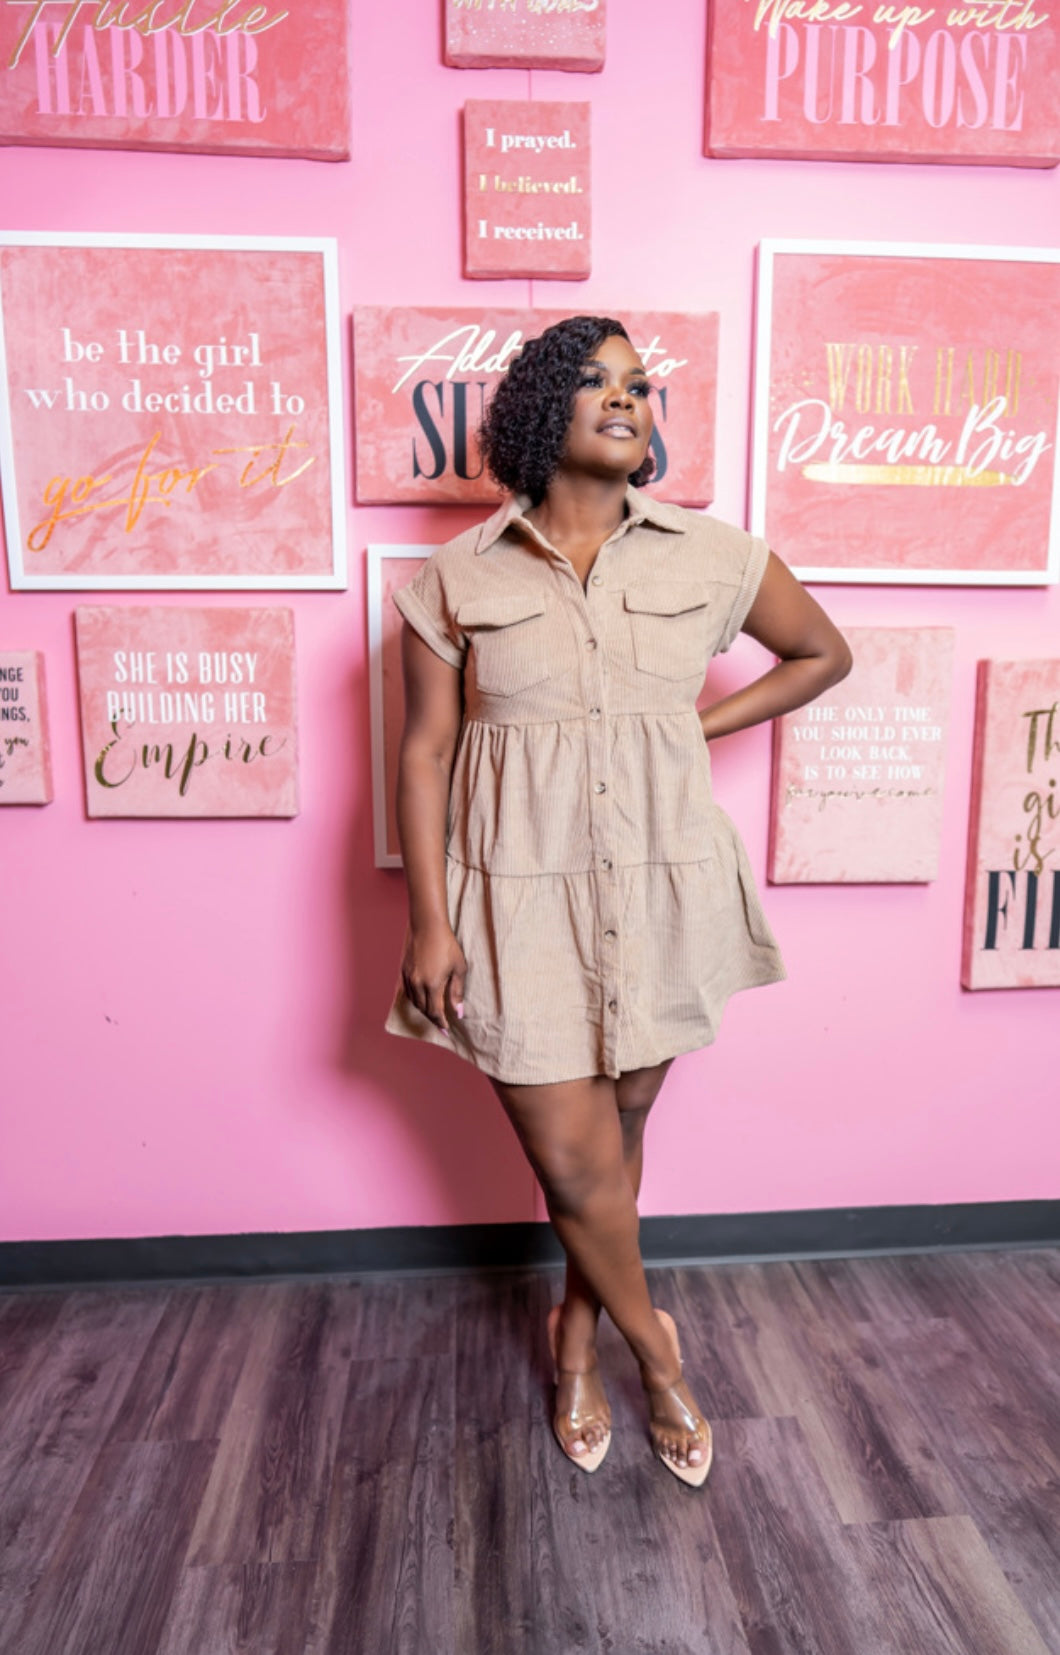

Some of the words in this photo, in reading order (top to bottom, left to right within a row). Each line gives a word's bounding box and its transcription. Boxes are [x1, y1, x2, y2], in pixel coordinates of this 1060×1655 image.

[873, 1, 934, 50] up
[946, 0, 1048, 30] with
[34, 22, 267, 124] HARDER
[760, 22, 1028, 132] PURPOSE
[485, 128, 495, 147] I
[501, 130, 576, 153] prayed.
[478, 174, 487, 192] I
[494, 175, 583, 194] believed.
[478, 220, 487, 238] I
[494, 222, 583, 240] received.
[60, 328, 104, 363] be
[116, 330, 181, 365] the
[193, 333, 263, 377] girl
[24, 378, 109, 412] who
[122, 379, 258, 415] decided
[270, 381, 304, 415] to
[824, 342, 918, 416] WORK
[933, 346, 1023, 417] HARD
[773, 398, 952, 472] Dream
[955, 395, 1052, 486] Big
[125, 431, 220, 533] for
[213, 424, 316, 488] it
[113, 651, 158, 684] SHE
[167, 652, 188, 684] IS
[199, 652, 258, 684] BUSY
[106, 690, 215, 724] BUILDING
[224, 692, 267, 723] HER
[807, 706, 838, 722] THE
[845, 706, 886, 722] ONLY
[894, 706, 931, 722] TIME
[94, 708, 287, 796] Empire
[792, 726, 822, 742] YOU
[831, 726, 896, 742] SHOULD
[901, 726, 942, 742] EVER
[820, 745, 861, 761] LOOK
[804, 765, 818, 781] IS
[826, 765, 846, 781] TO
[852, 765, 881, 781] SEE
[887, 765, 924, 781] HOW
[1013, 834, 1056, 877] is
